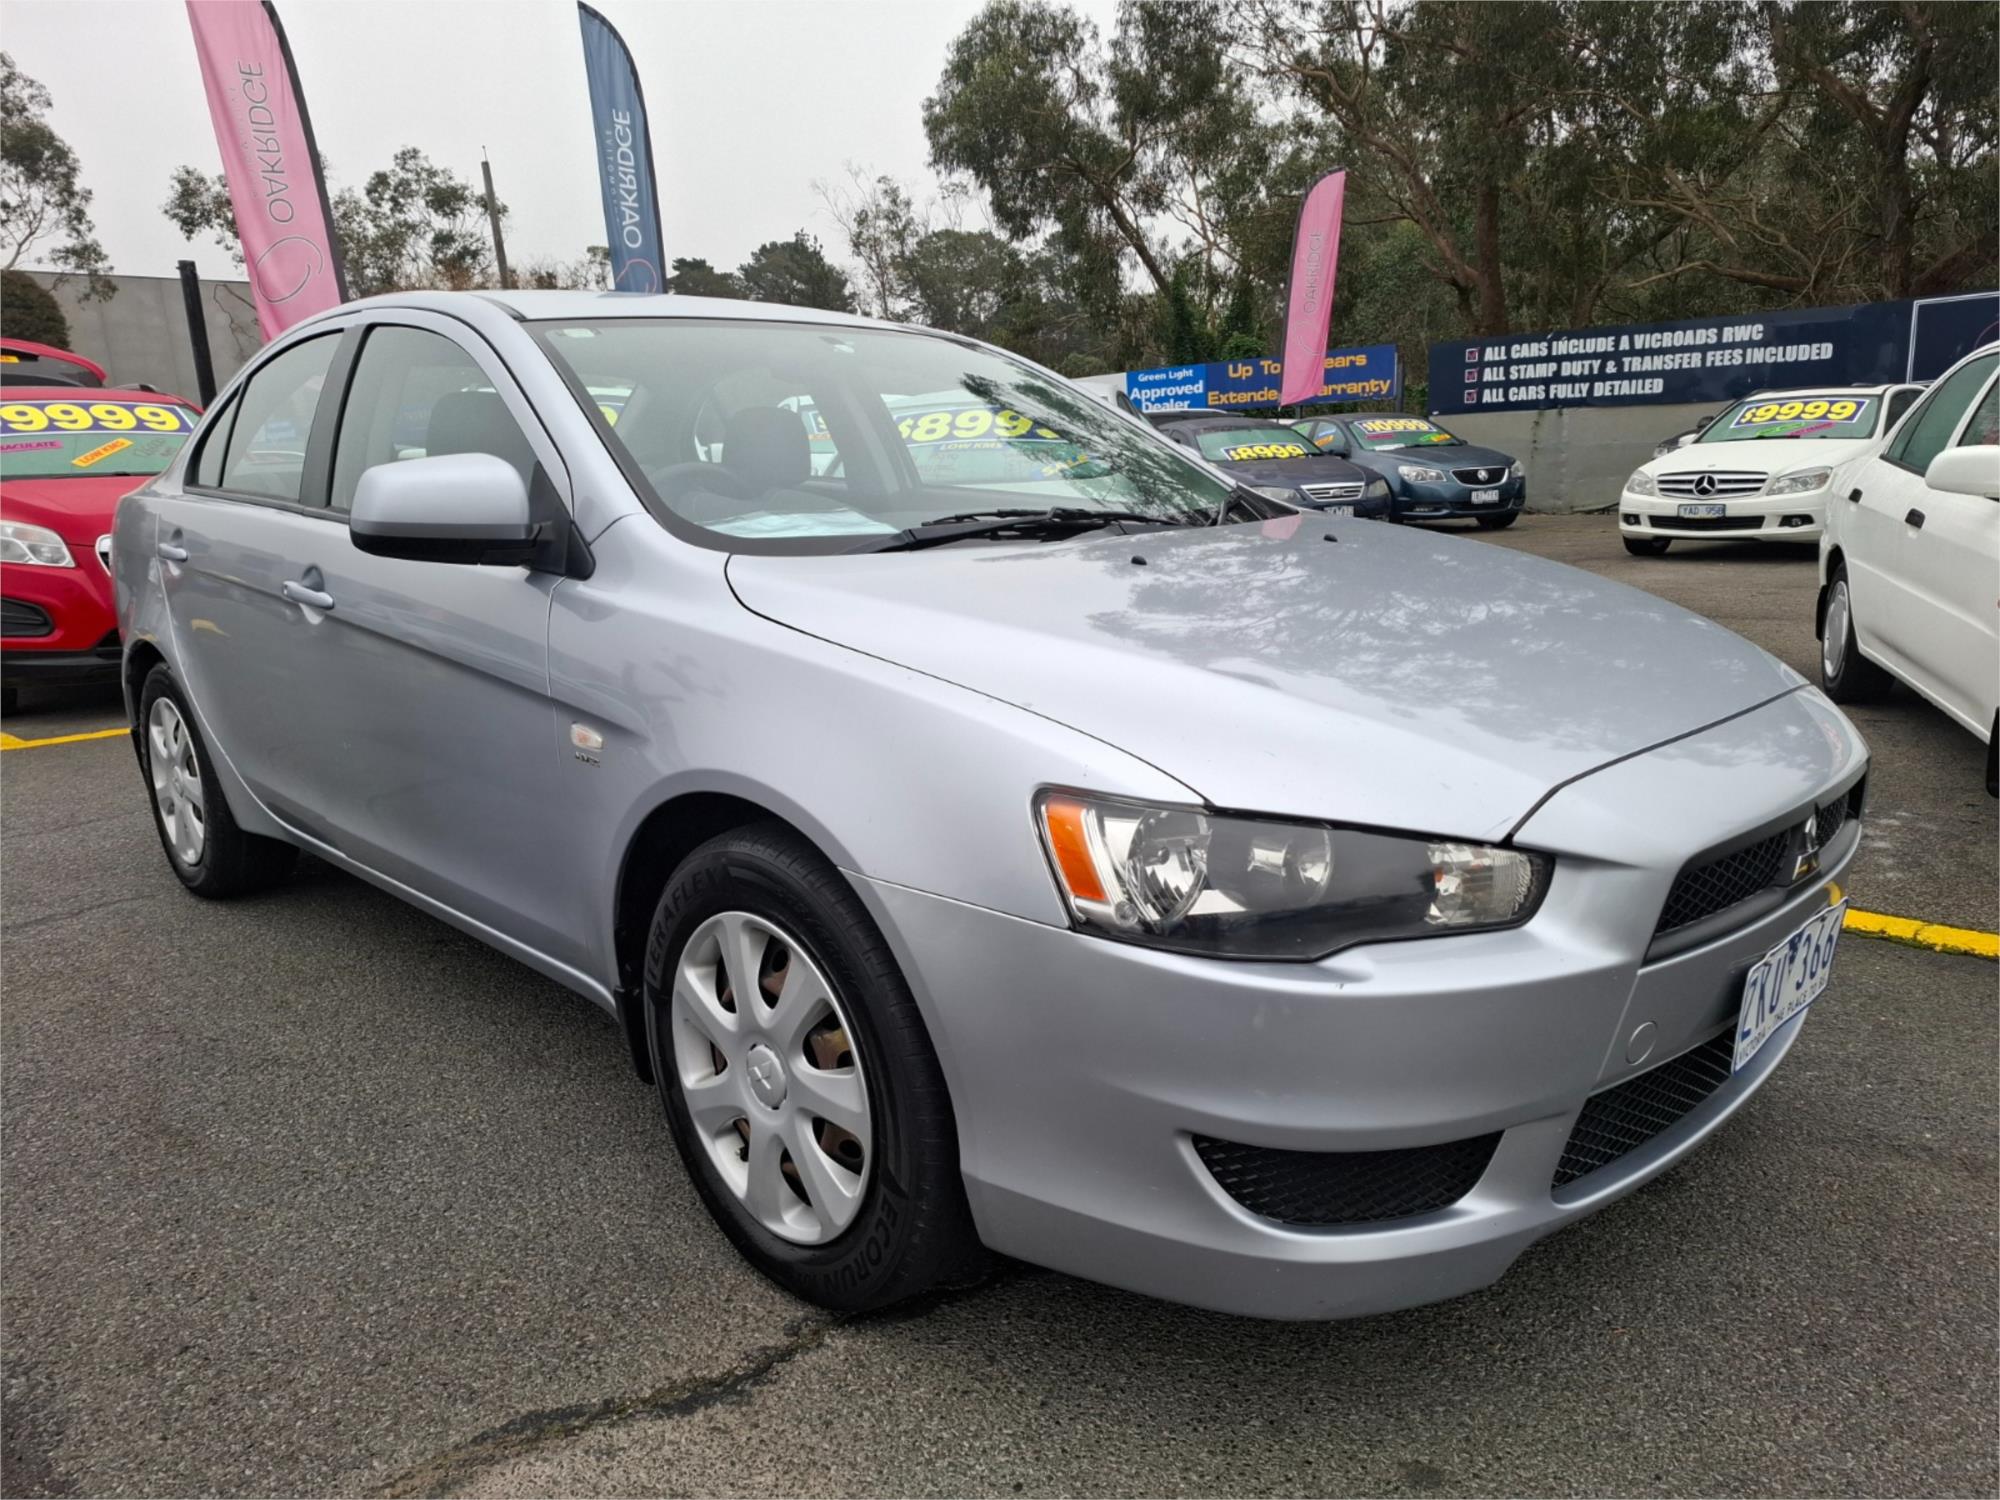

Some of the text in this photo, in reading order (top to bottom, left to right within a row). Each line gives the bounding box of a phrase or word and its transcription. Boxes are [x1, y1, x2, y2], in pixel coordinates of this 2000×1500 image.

[1484, 323, 1764, 362] ALL CARS INCLUDE A VICROADS RWC
[1228, 354, 1367, 380] Up To ears
[1483, 342, 1834, 382] ALL STAMP DUTY & TRANSFER FEES INCLUDED
[1138, 368, 1194, 382] Green Light
[1130, 379, 1204, 401] Approved
[1208, 387, 1279, 406] Extende
[1317, 379, 1392, 398] arranty
[1482, 378, 1664, 403] ALL CARS FULLY DETAILED
[1142, 398, 1191, 413] Dealer
[1740, 400, 1857, 424] $9999
[898, 409, 1059, 442] $899
